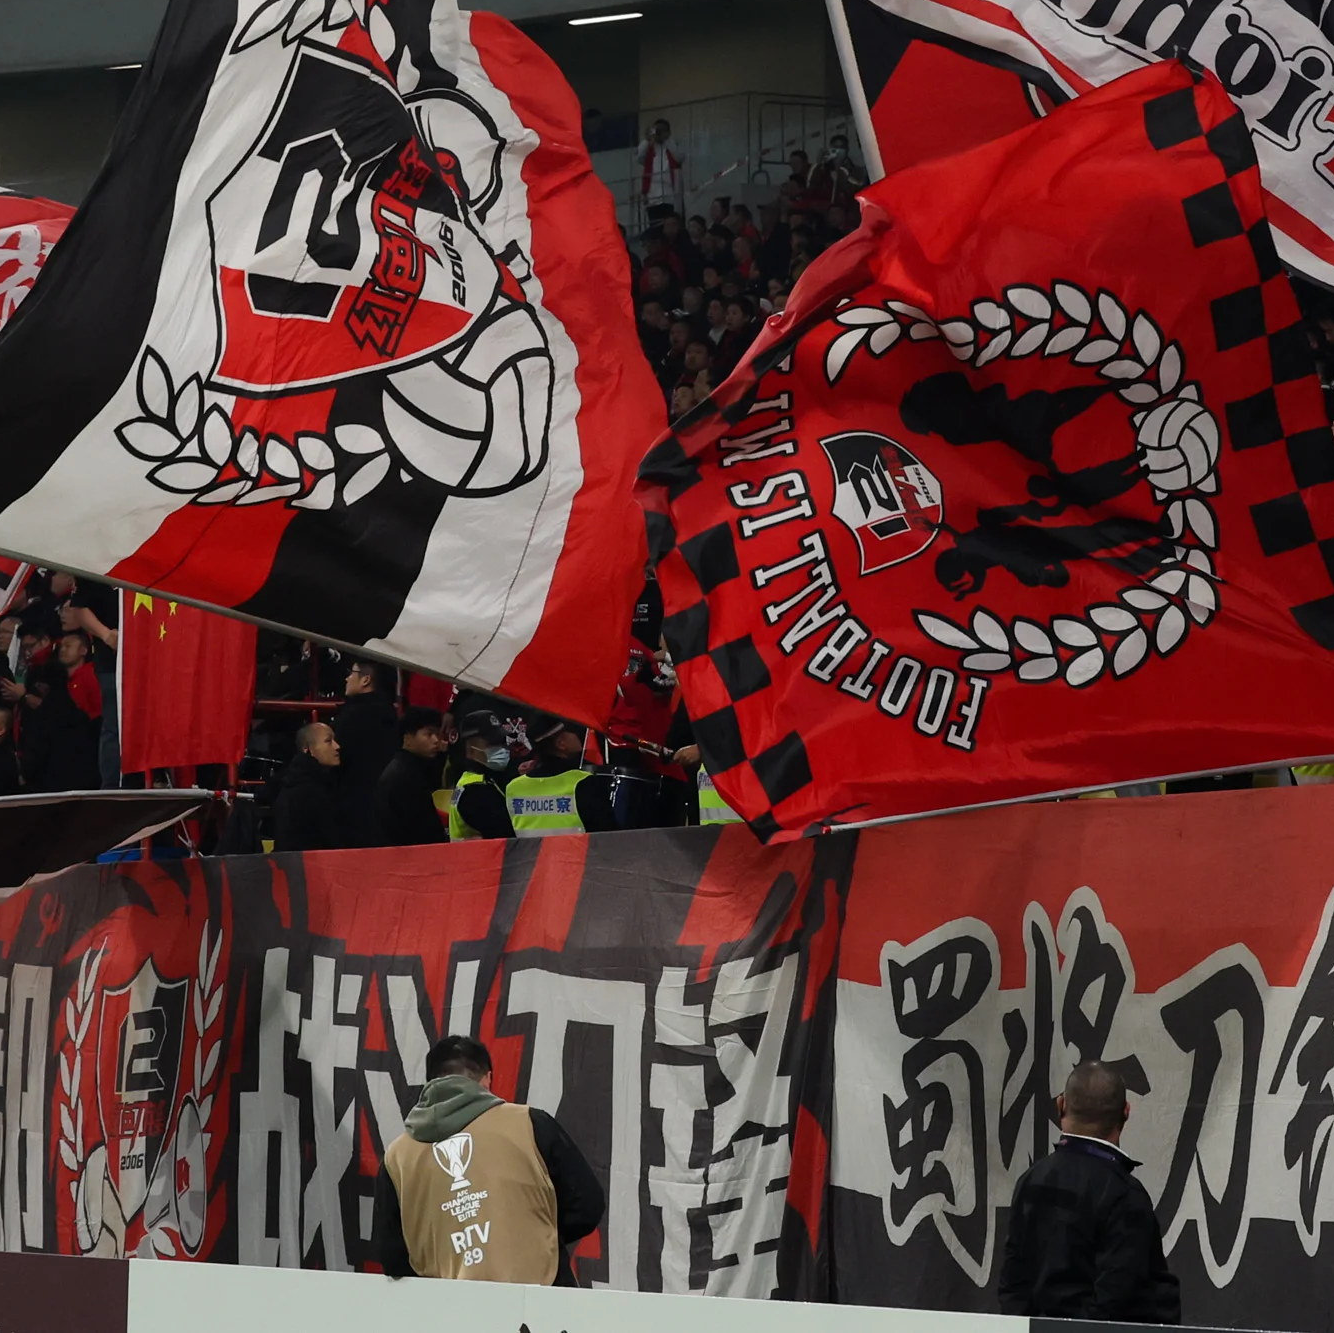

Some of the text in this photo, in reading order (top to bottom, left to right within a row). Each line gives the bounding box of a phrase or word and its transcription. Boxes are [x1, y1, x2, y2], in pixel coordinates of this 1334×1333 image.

[755, 527, 989, 753] FOOTBALL
[525, 798, 555, 813] POLICE
[120, 1152, 145, 1170] 2006
[441, 1190, 488, 1211] CHAMPIONS
[456, 1189, 469, 1198] AFC
[450, 1200, 481, 1216] LEAGUE
[457, 1209, 478, 1223] ELITE
[450, 1221, 491, 1254] RTV
[463, 1247, 484, 1266] 89
